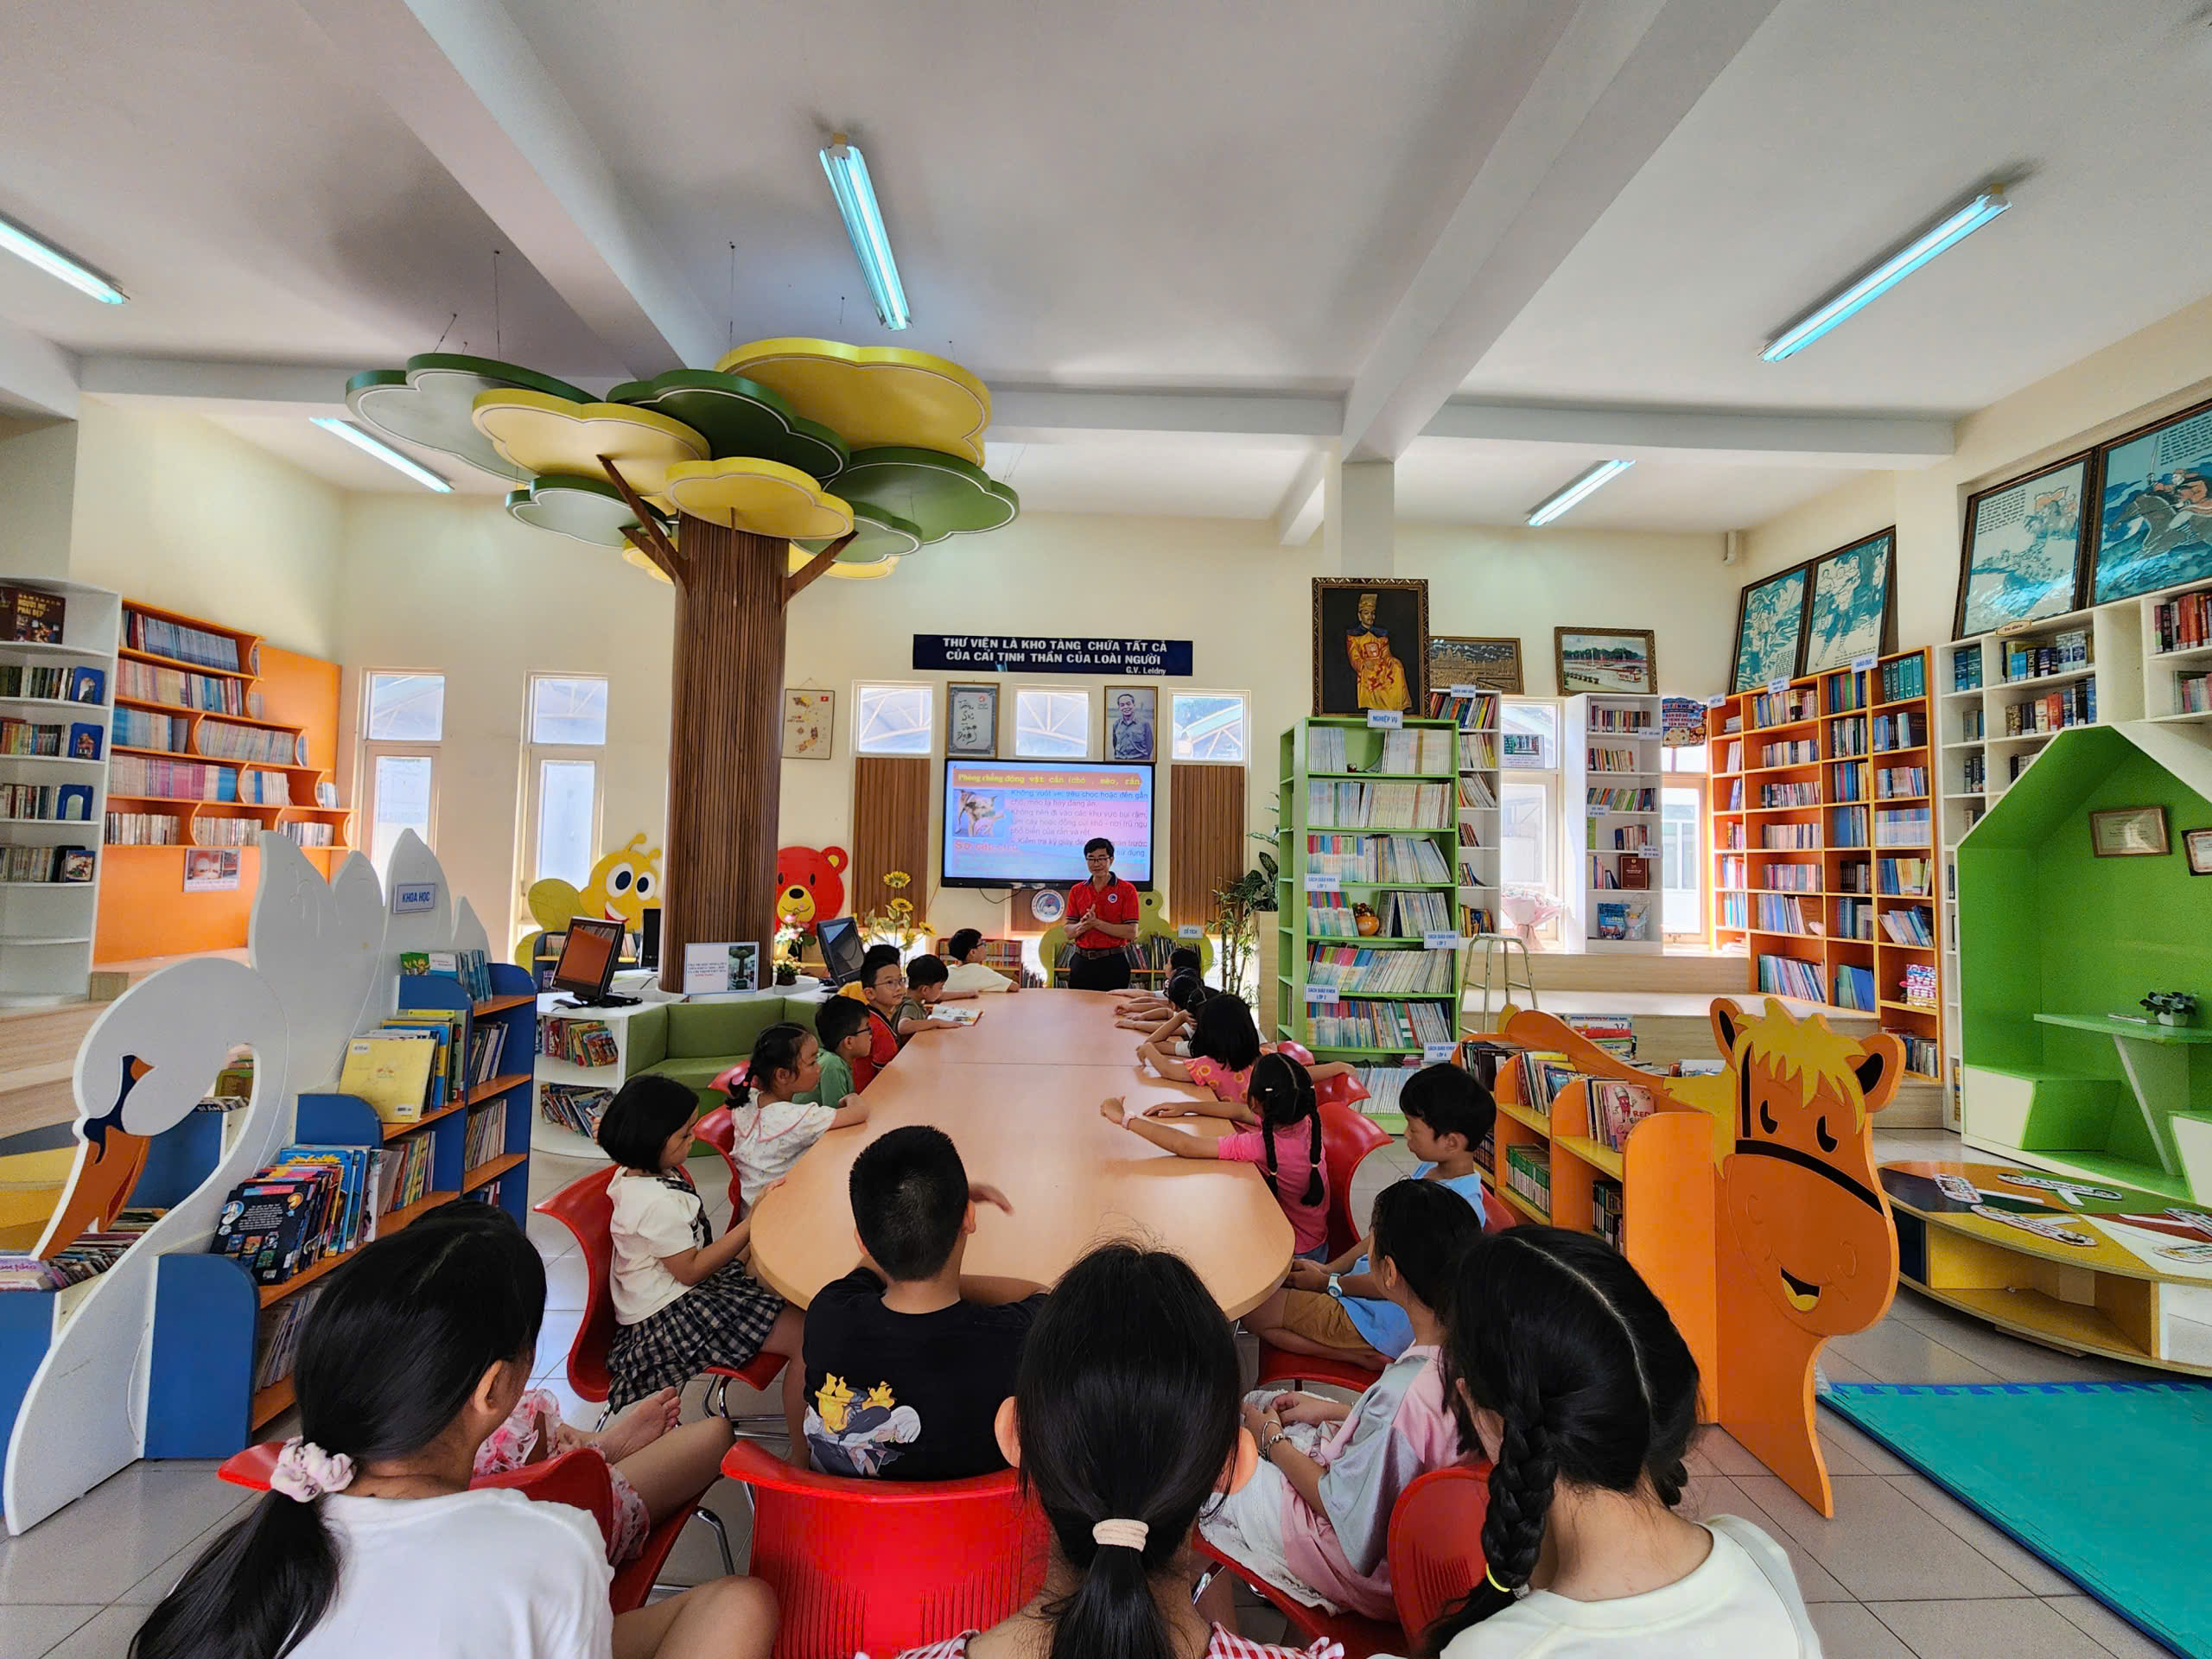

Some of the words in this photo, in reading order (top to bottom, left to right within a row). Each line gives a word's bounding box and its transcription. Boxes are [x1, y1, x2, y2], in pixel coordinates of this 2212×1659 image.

[943, 638, 968, 647] THƯ
[970, 637, 998, 650] VIỆN
[1002, 638, 1018, 649] LÀ
[1021, 639, 1046, 649] KHO
[1050, 639, 1081, 651] TÀNG
[1088, 639, 1120, 651] CHỨA
[1125, 639, 1147, 652] TẤT
[1152, 640, 1167, 652] CẢ
[946, 648, 970, 660] CỦA
[974, 649, 995, 661] CẢI
[997, 652, 1025, 662] TINH
[1066, 651, 1090, 664] CỦA
[1094, 652, 1121, 664] LOÀI
[1125, 652, 1160, 664] NGƯỜI
[1372, 715, 1390, 723] NGHIỆP
[402, 892, 418, 904] KHOA
[418, 891, 430, 904] HỌC
